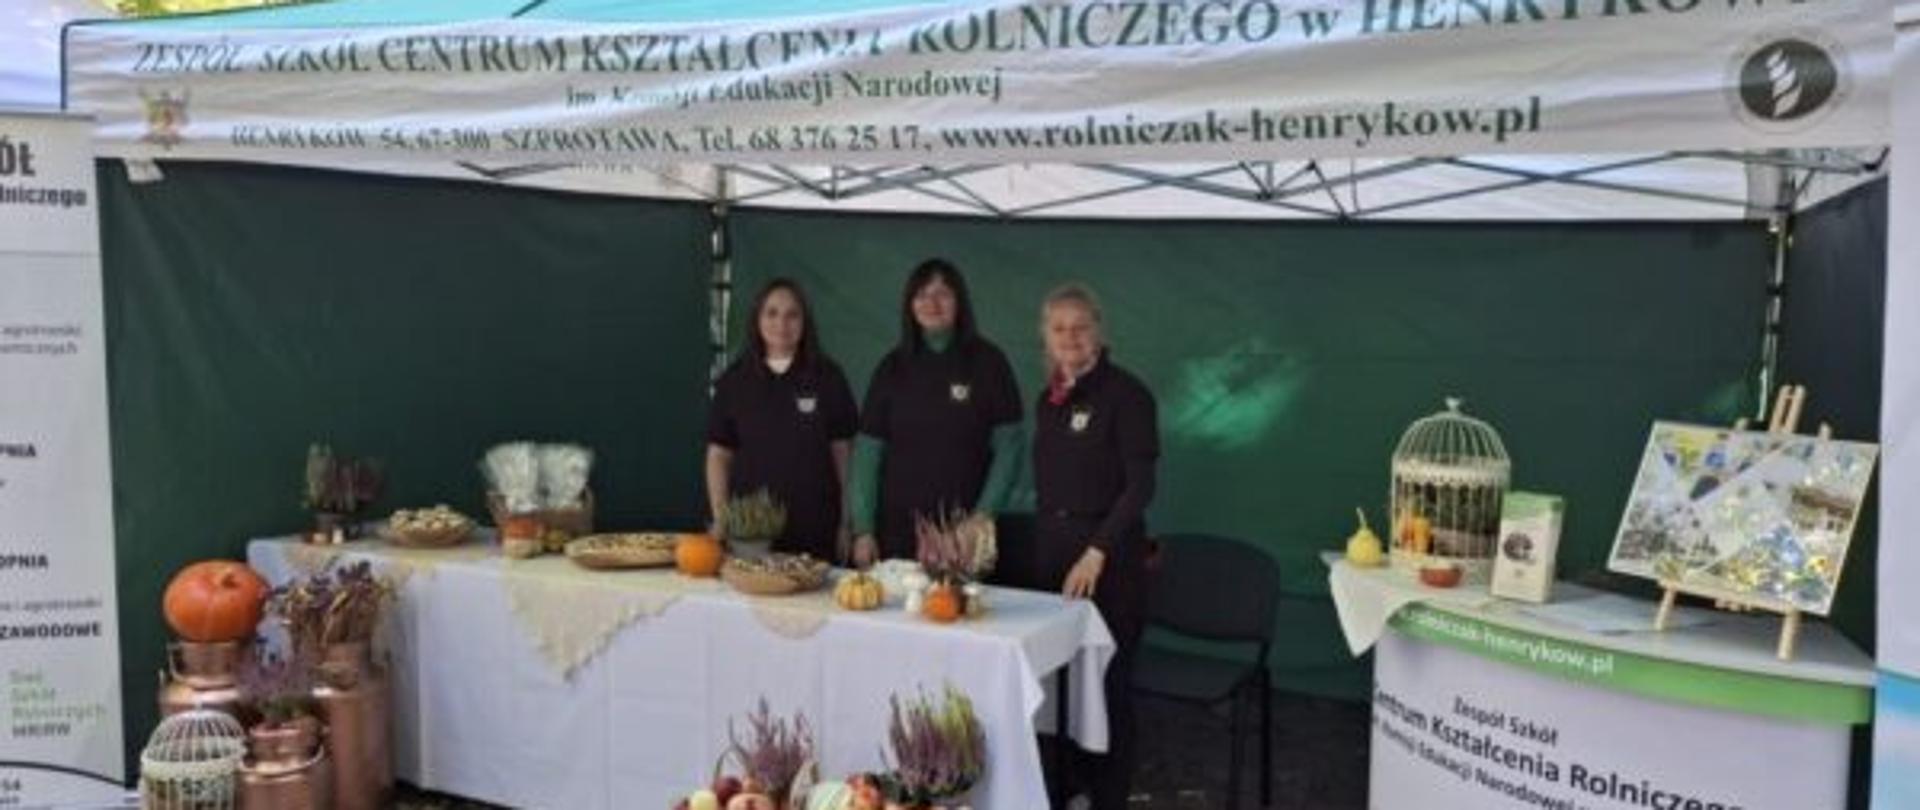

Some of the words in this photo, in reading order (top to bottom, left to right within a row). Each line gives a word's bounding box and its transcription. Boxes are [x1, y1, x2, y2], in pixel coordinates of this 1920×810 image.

[378, 35, 567, 72] CENTRUM
[1298, 8, 1340, 38] w
[842, 67, 1003, 101] Narodowej
[694, 125, 744, 151] Tel.
[749, 126, 782, 151] 68
[789, 124, 837, 151] 376
[846, 124, 878, 151] 25
[889, 125, 932, 152] 17,
[940, 97, 1542, 151] www.rolniczak-henrykow.pl
[1371, 681, 1428, 731] entrum
[1431, 715, 1560, 782] Kształcenia
[1570, 763, 1743, 810] Rolnicze
